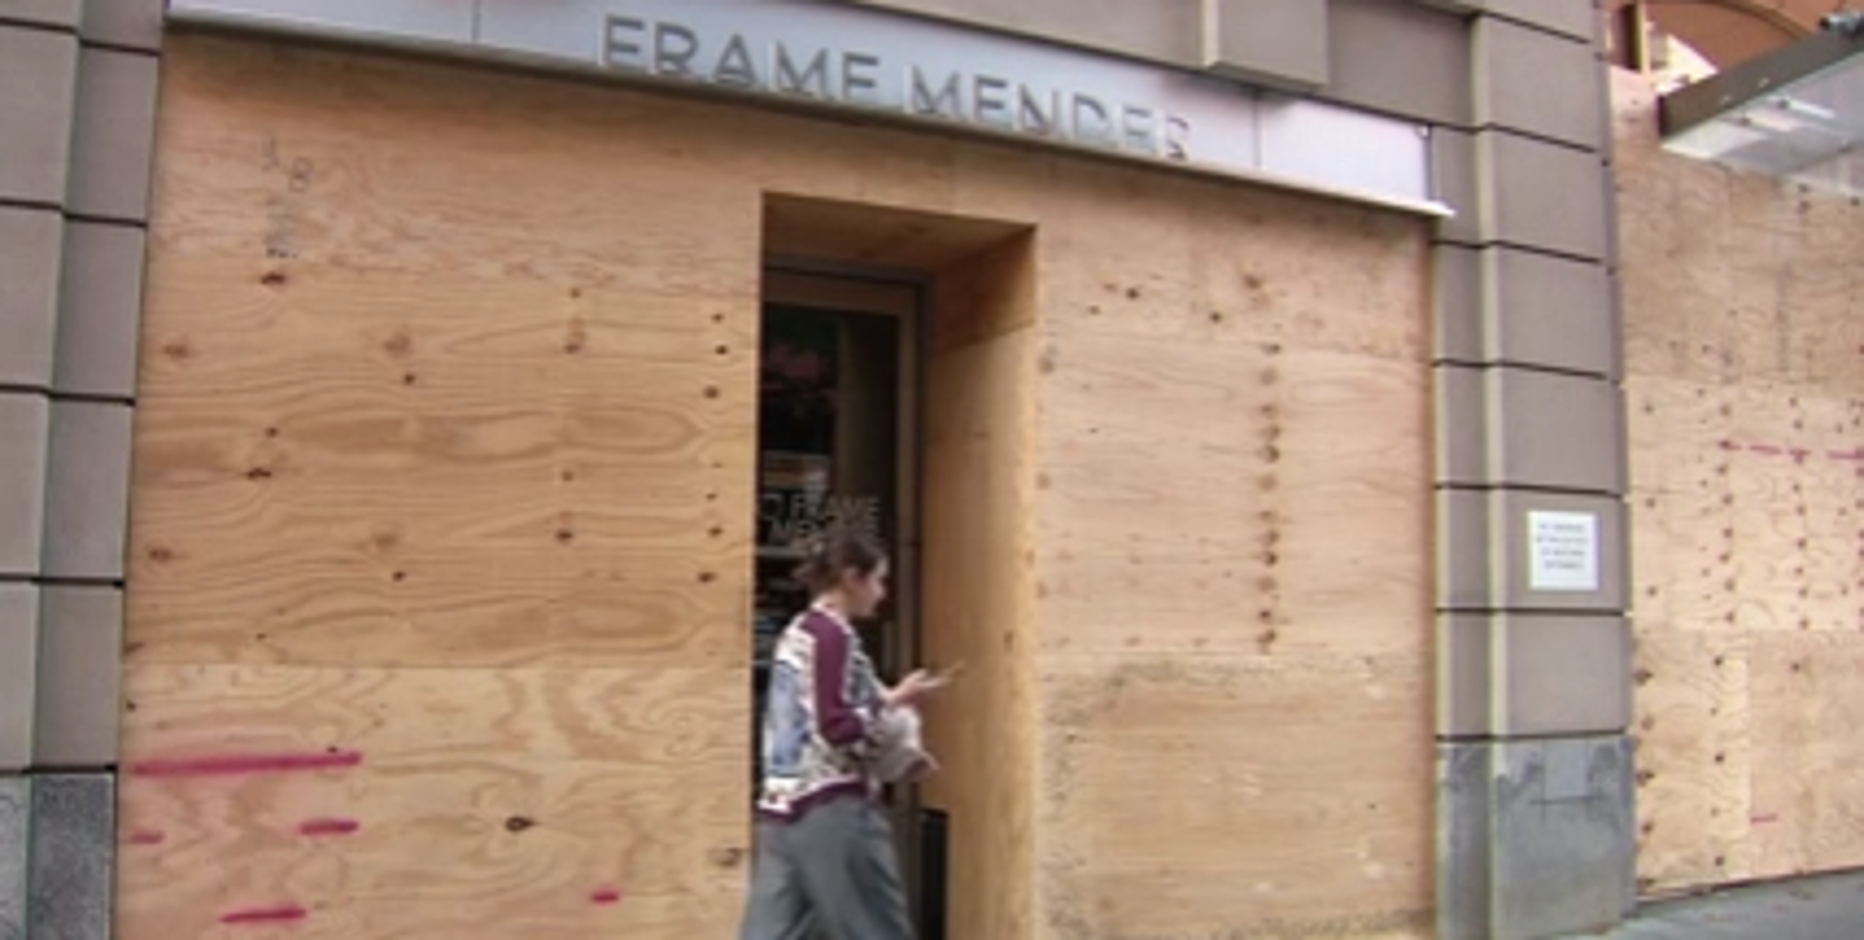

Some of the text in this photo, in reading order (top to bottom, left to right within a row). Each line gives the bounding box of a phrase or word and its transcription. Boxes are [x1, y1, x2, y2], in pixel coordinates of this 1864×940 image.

[600, 14, 1190, 160] FRAME MENDES
[789, 493, 880, 522] FRAME
